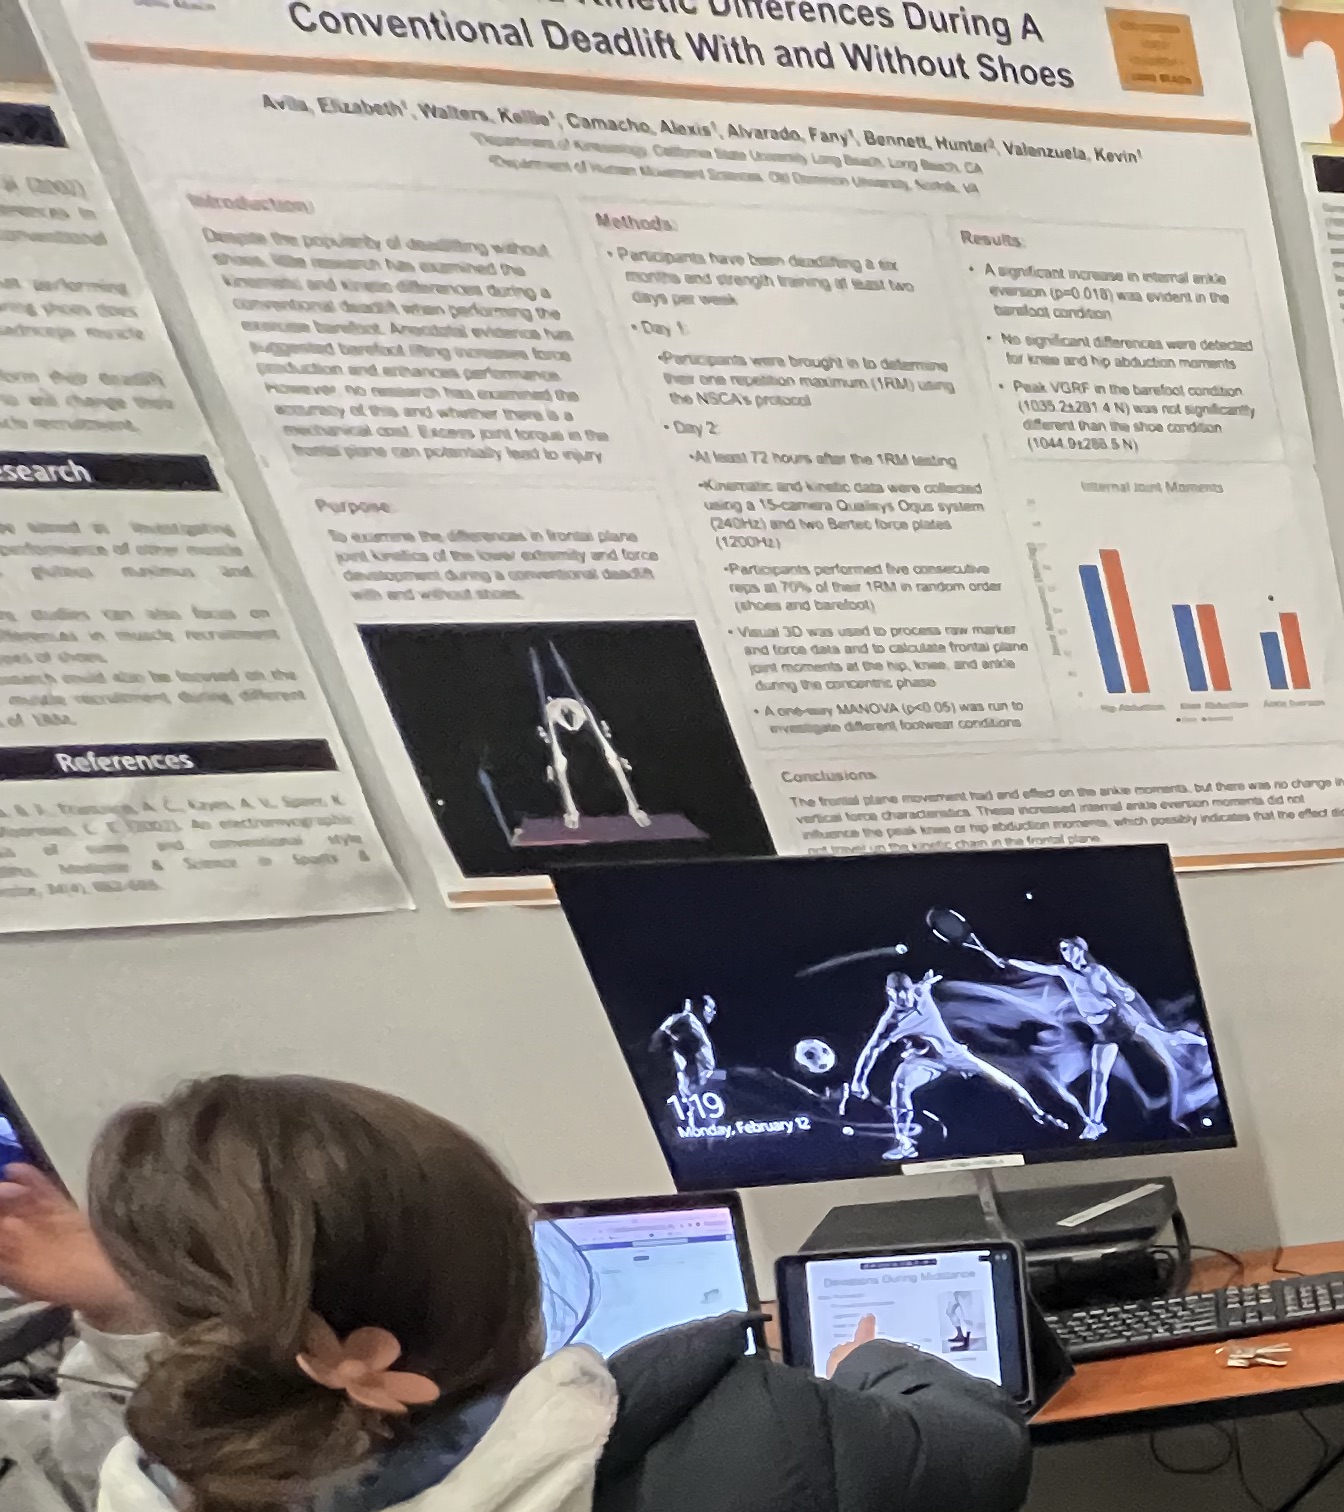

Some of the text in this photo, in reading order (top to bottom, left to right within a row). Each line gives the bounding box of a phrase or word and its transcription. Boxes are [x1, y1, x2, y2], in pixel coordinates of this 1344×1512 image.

[905, 1, 1010, 45] During
[1020, 12, 1045, 43] A
[289, 1, 1076, 90] Conventional Deadlift With and Without Shoes
[566, 112, 656, 137] Camacho,
[727, 122, 804, 143] Alvarado,
[55, 751, 195, 778] References
[666, 1092, 725, 1121] 1:19
[678, 1116, 811, 1140] Monday, February 12
